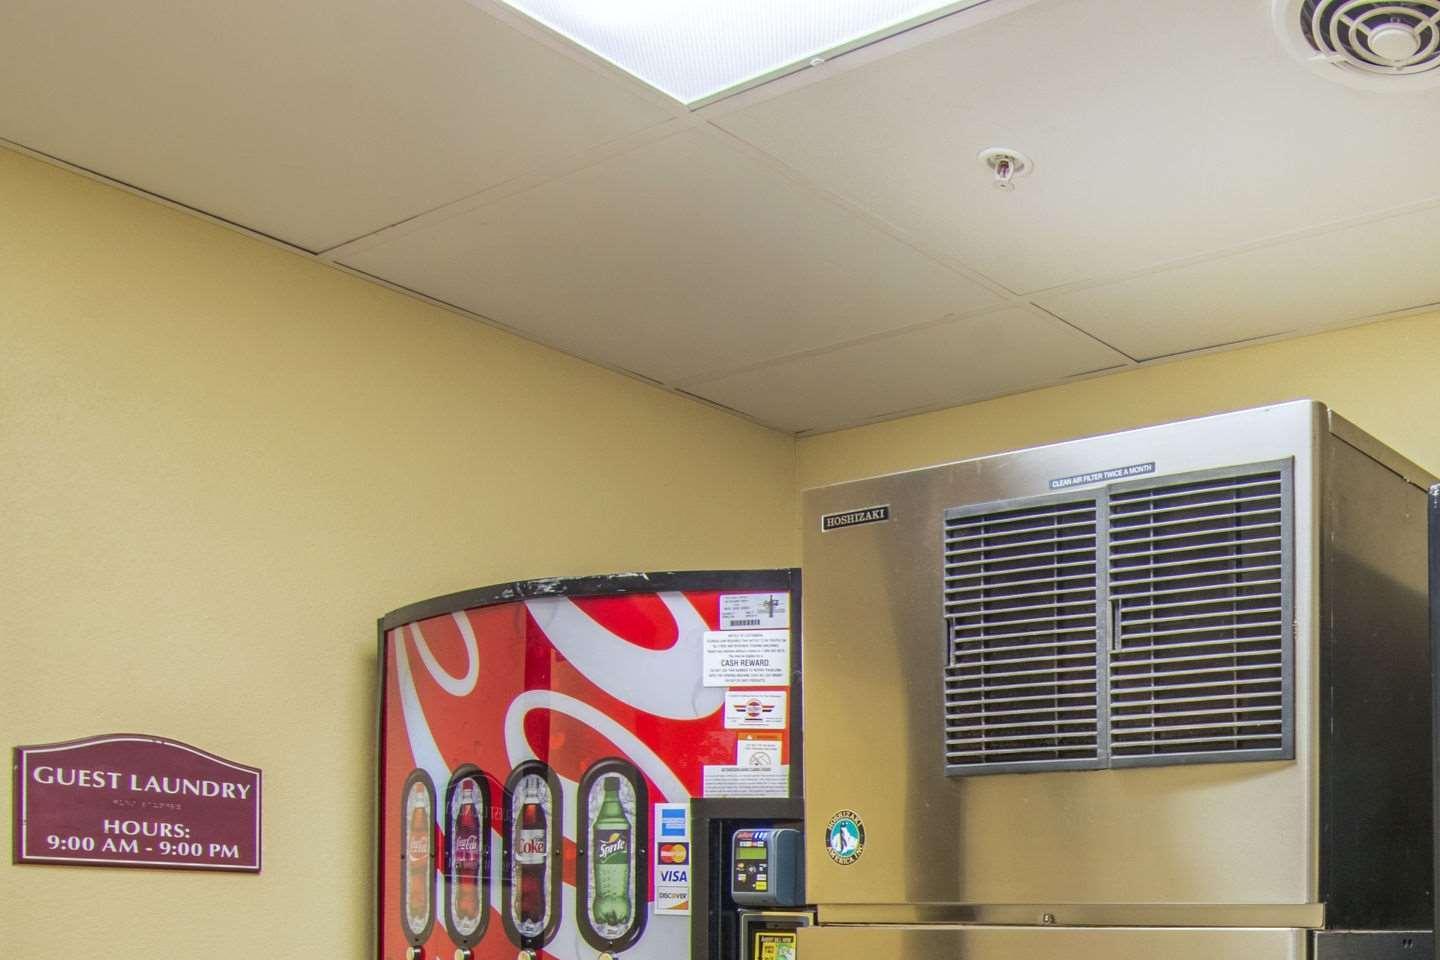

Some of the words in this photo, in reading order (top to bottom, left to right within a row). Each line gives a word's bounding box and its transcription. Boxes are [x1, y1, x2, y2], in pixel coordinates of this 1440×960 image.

[1052, 478, 1072, 488] CLEAN
[1073, 477, 1082, 485] AIR
[1083, 473, 1103, 483] FILTER
[1103, 470, 1122, 479] TWICE
[1129, 464, 1153, 474] MONTH
[826, 509, 885, 527] HOSHIZAKI
[720, 659, 739, 668] CASH
[740, 658, 770, 668] REWARD
[33, 766, 122, 789] GUEST
[130, 773, 251, 800] LAUNDRY
[103, 819, 191, 838] HOURS:
[47, 835, 95, 851] 9:00
[102, 837, 139, 854] AM
[159, 841, 203, 857] 9:00
[209, 843, 240, 859] PM
[599, 838, 626, 858] Sprite
[660, 870, 687, 882] VISA
